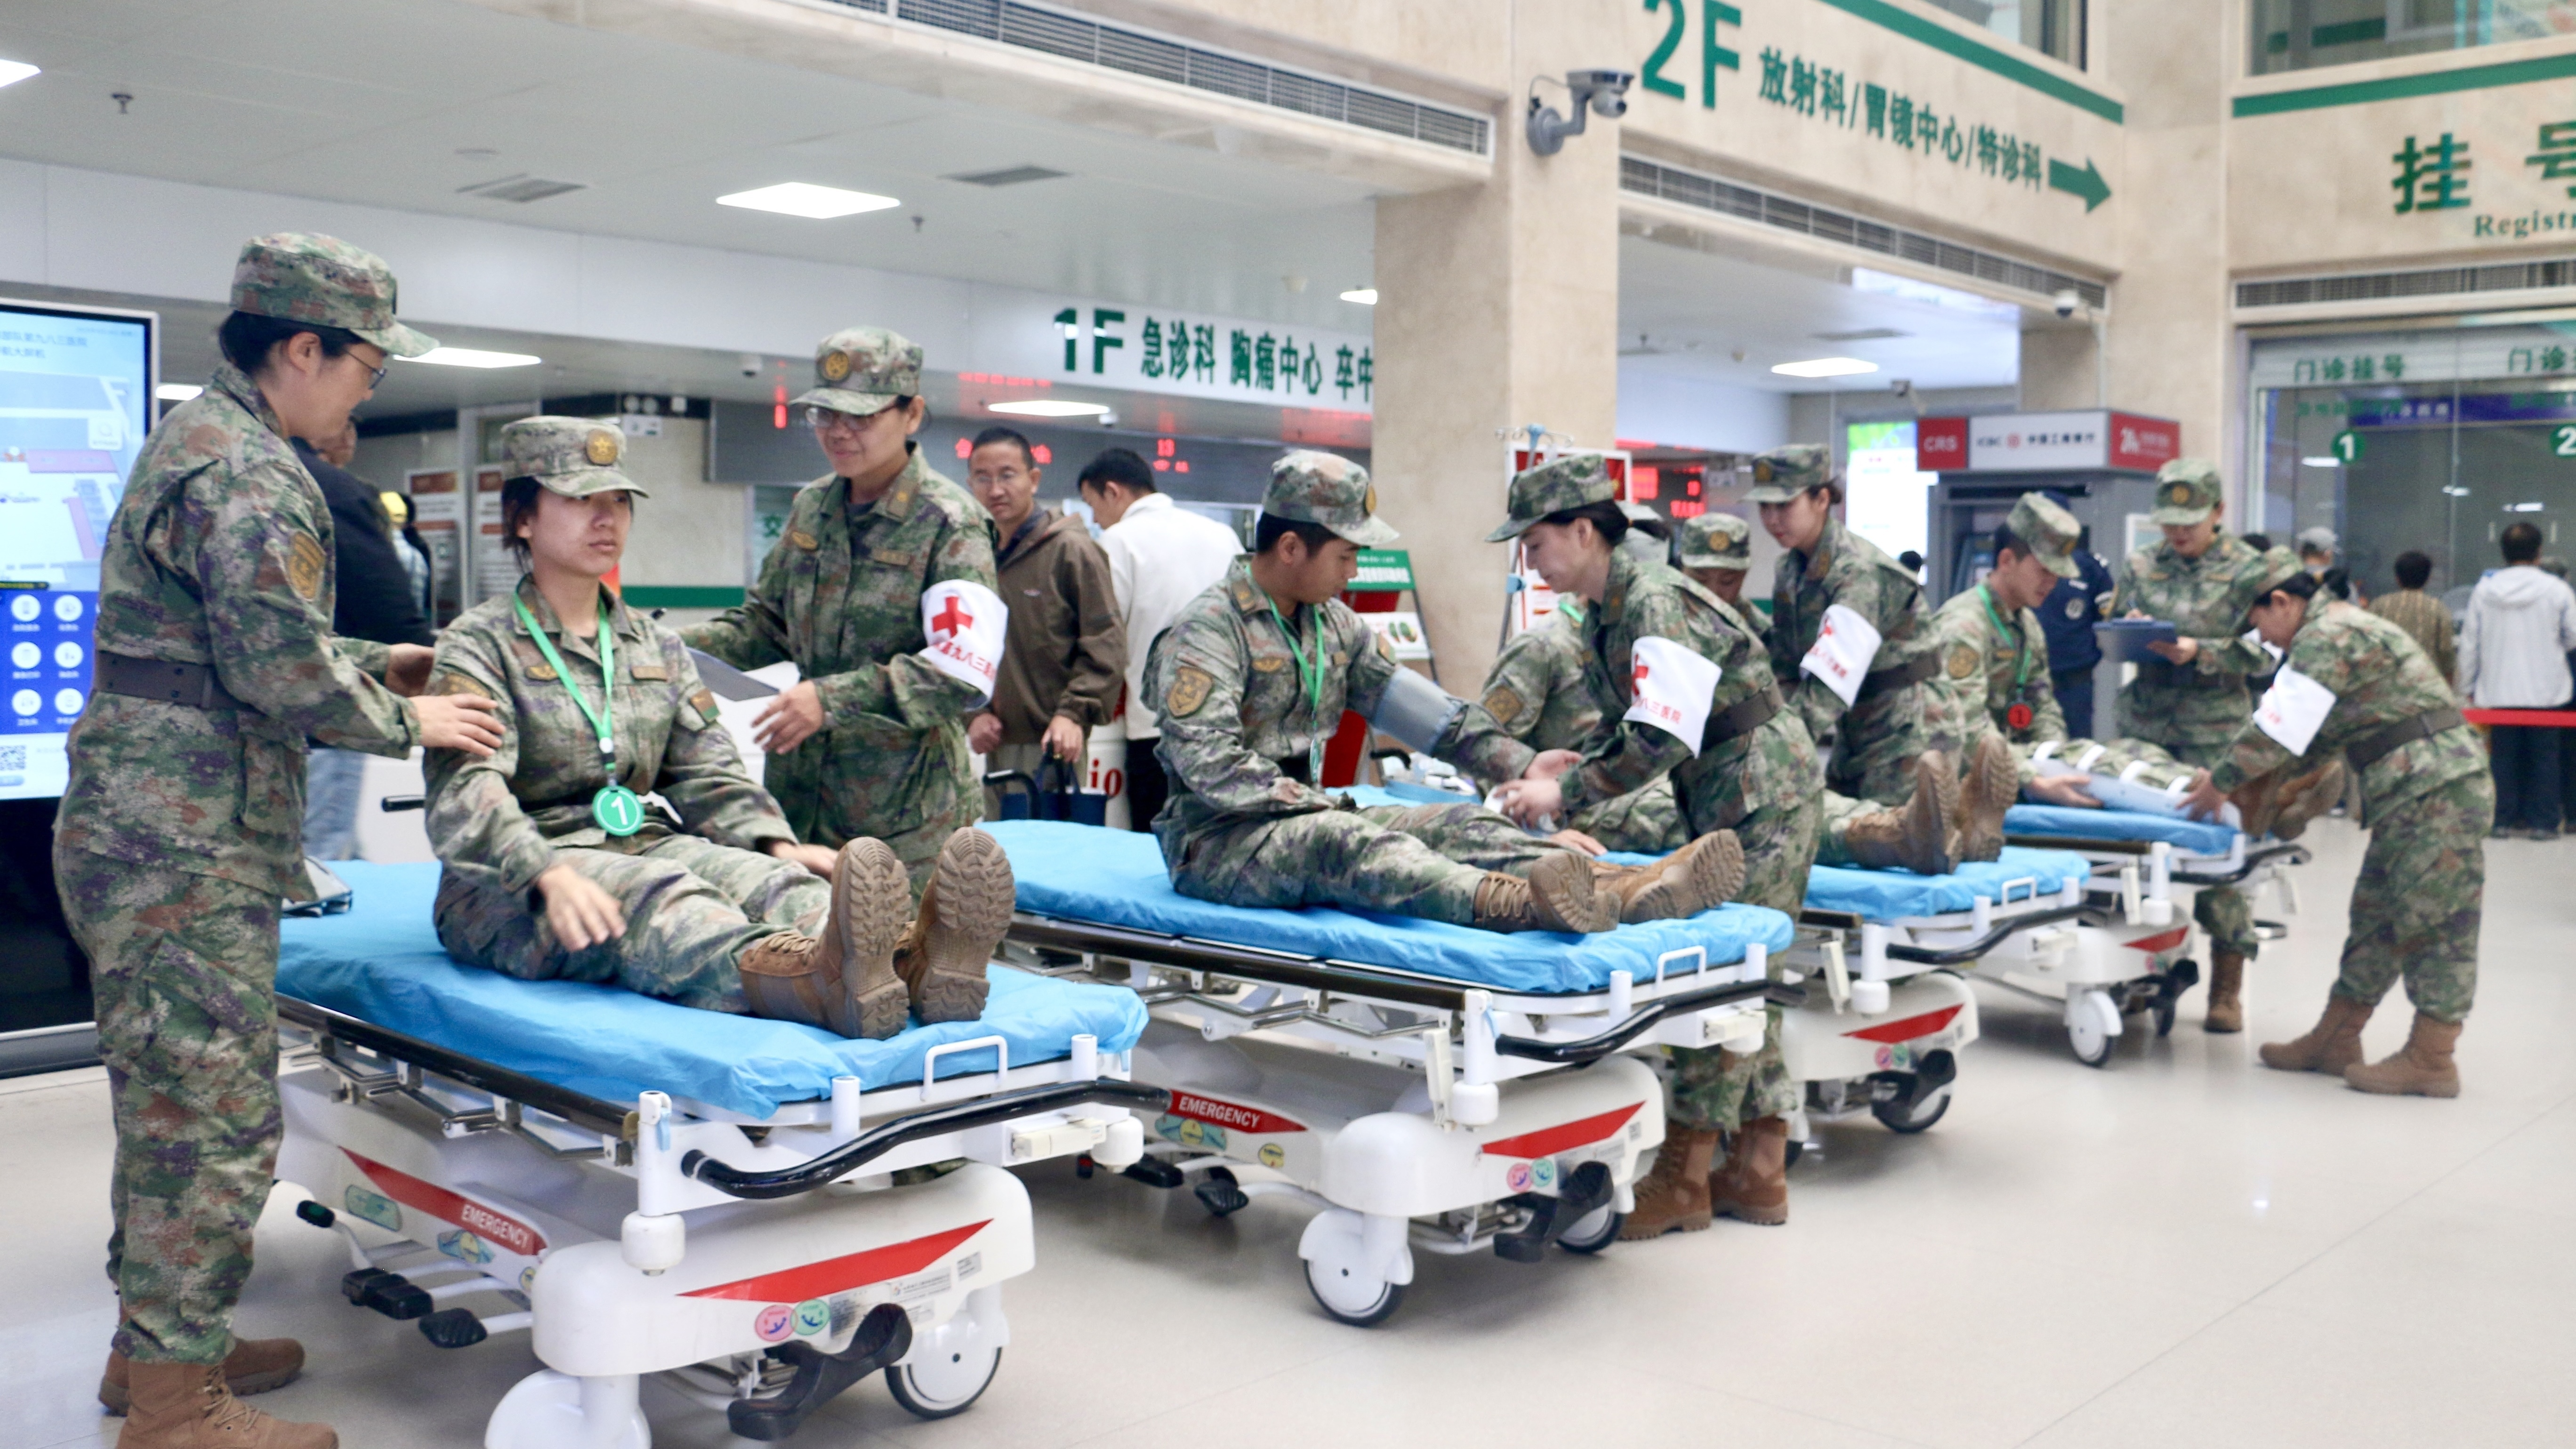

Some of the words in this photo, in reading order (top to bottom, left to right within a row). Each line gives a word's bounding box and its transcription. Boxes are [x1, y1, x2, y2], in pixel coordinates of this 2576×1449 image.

[1642, 0, 1741, 110] 2F
[1759, 45, 2042, 193] 放射科/胃镜中心/特诊科
[2392, 120, 2576, 214] 挂号
[1054, 307, 1125, 374] 1F
[1141, 315, 1216, 384] 急诊科
[1230, 329, 1322, 395] 胸痛中心
[1335, 343, 1373, 402] 卒中
[2509, 346, 2576, 372] 门诊
[2338, 434, 2354, 461] 1
[2557, 427, 2576, 456] 2
[611, 796, 628, 826] 1
[1178, 1095, 1260, 1128] EMERGENCY
[461, 1204, 529, 1248] EMERGENCY
